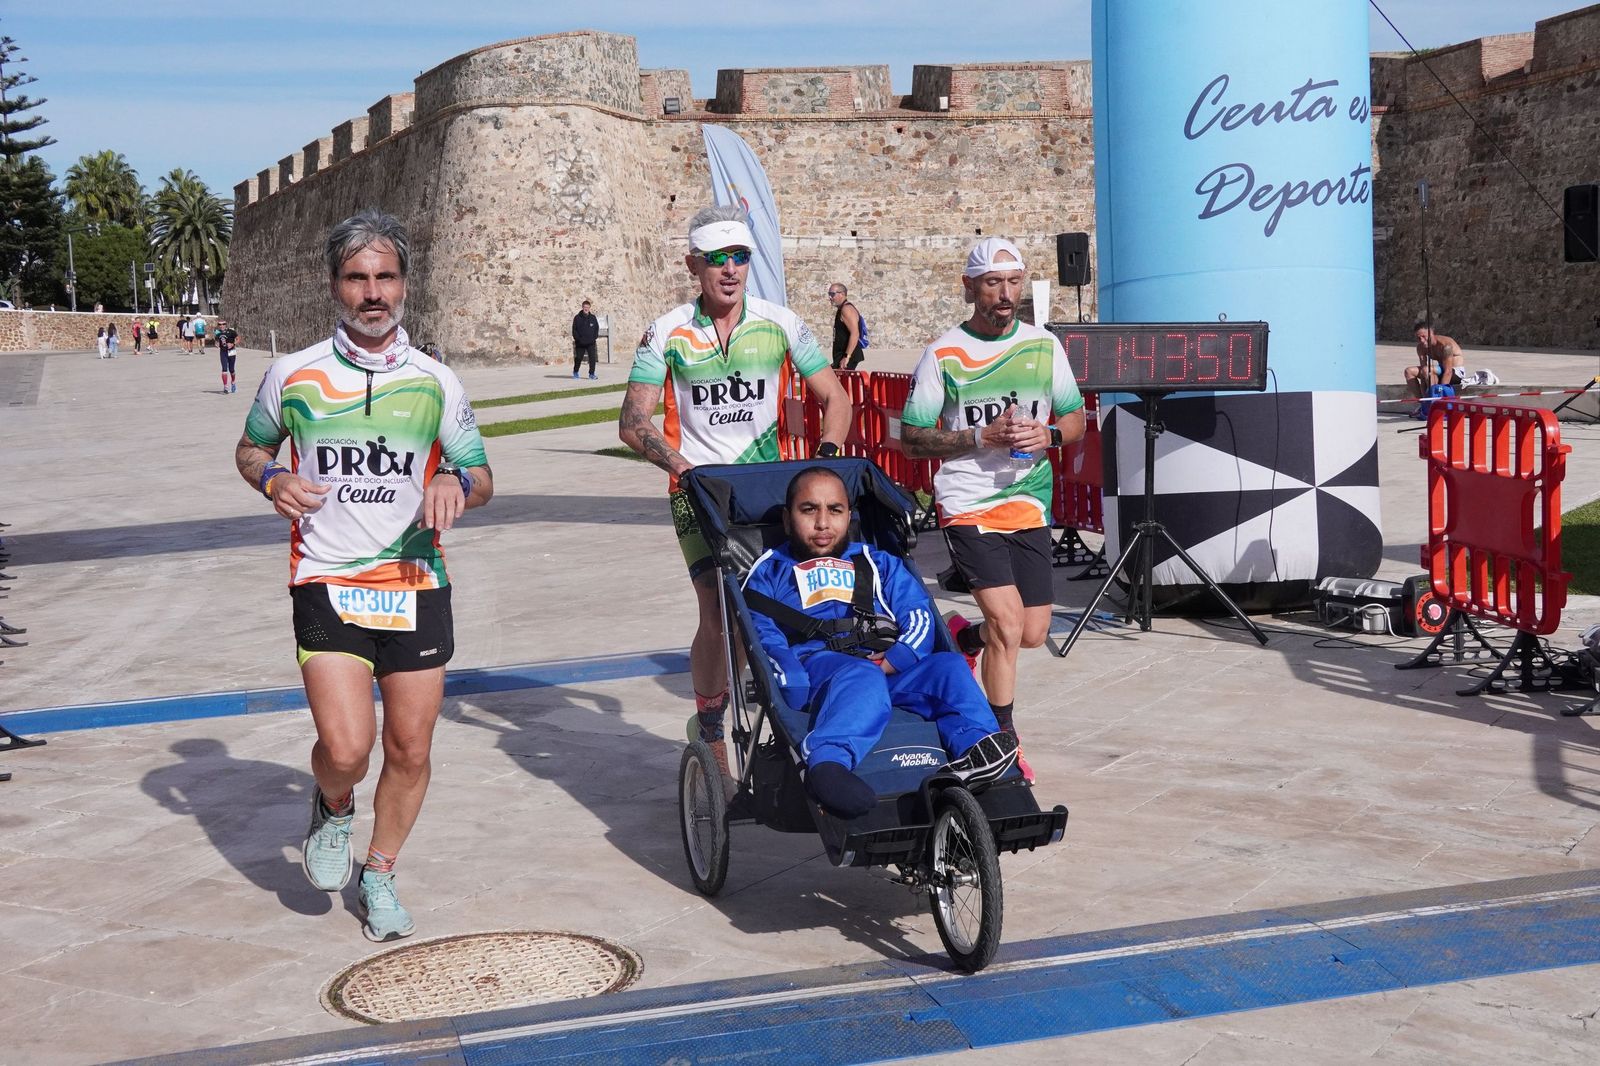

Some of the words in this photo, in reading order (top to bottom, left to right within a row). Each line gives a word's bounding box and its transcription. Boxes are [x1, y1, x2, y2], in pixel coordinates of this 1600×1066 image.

[1184, 74, 1339, 140] Ceuta
[1348, 96, 1369, 124] es
[1195, 162, 1371, 237] Deporte
[690, 377, 722, 385] ASOCIACIÓN
[963, 397, 996, 405] ASOCIACIÓN
[708, 408, 754, 426] Ceuta
[316, 438, 358, 446] ASOCIACIÓN
[319, 476, 353, 484] PROGRAMA
[337, 483, 397, 504] Ceuta
[337, 588, 408, 614] #0302
[891, 752, 932, 762] Advance
[900, 757, 938, 768] Mobility
